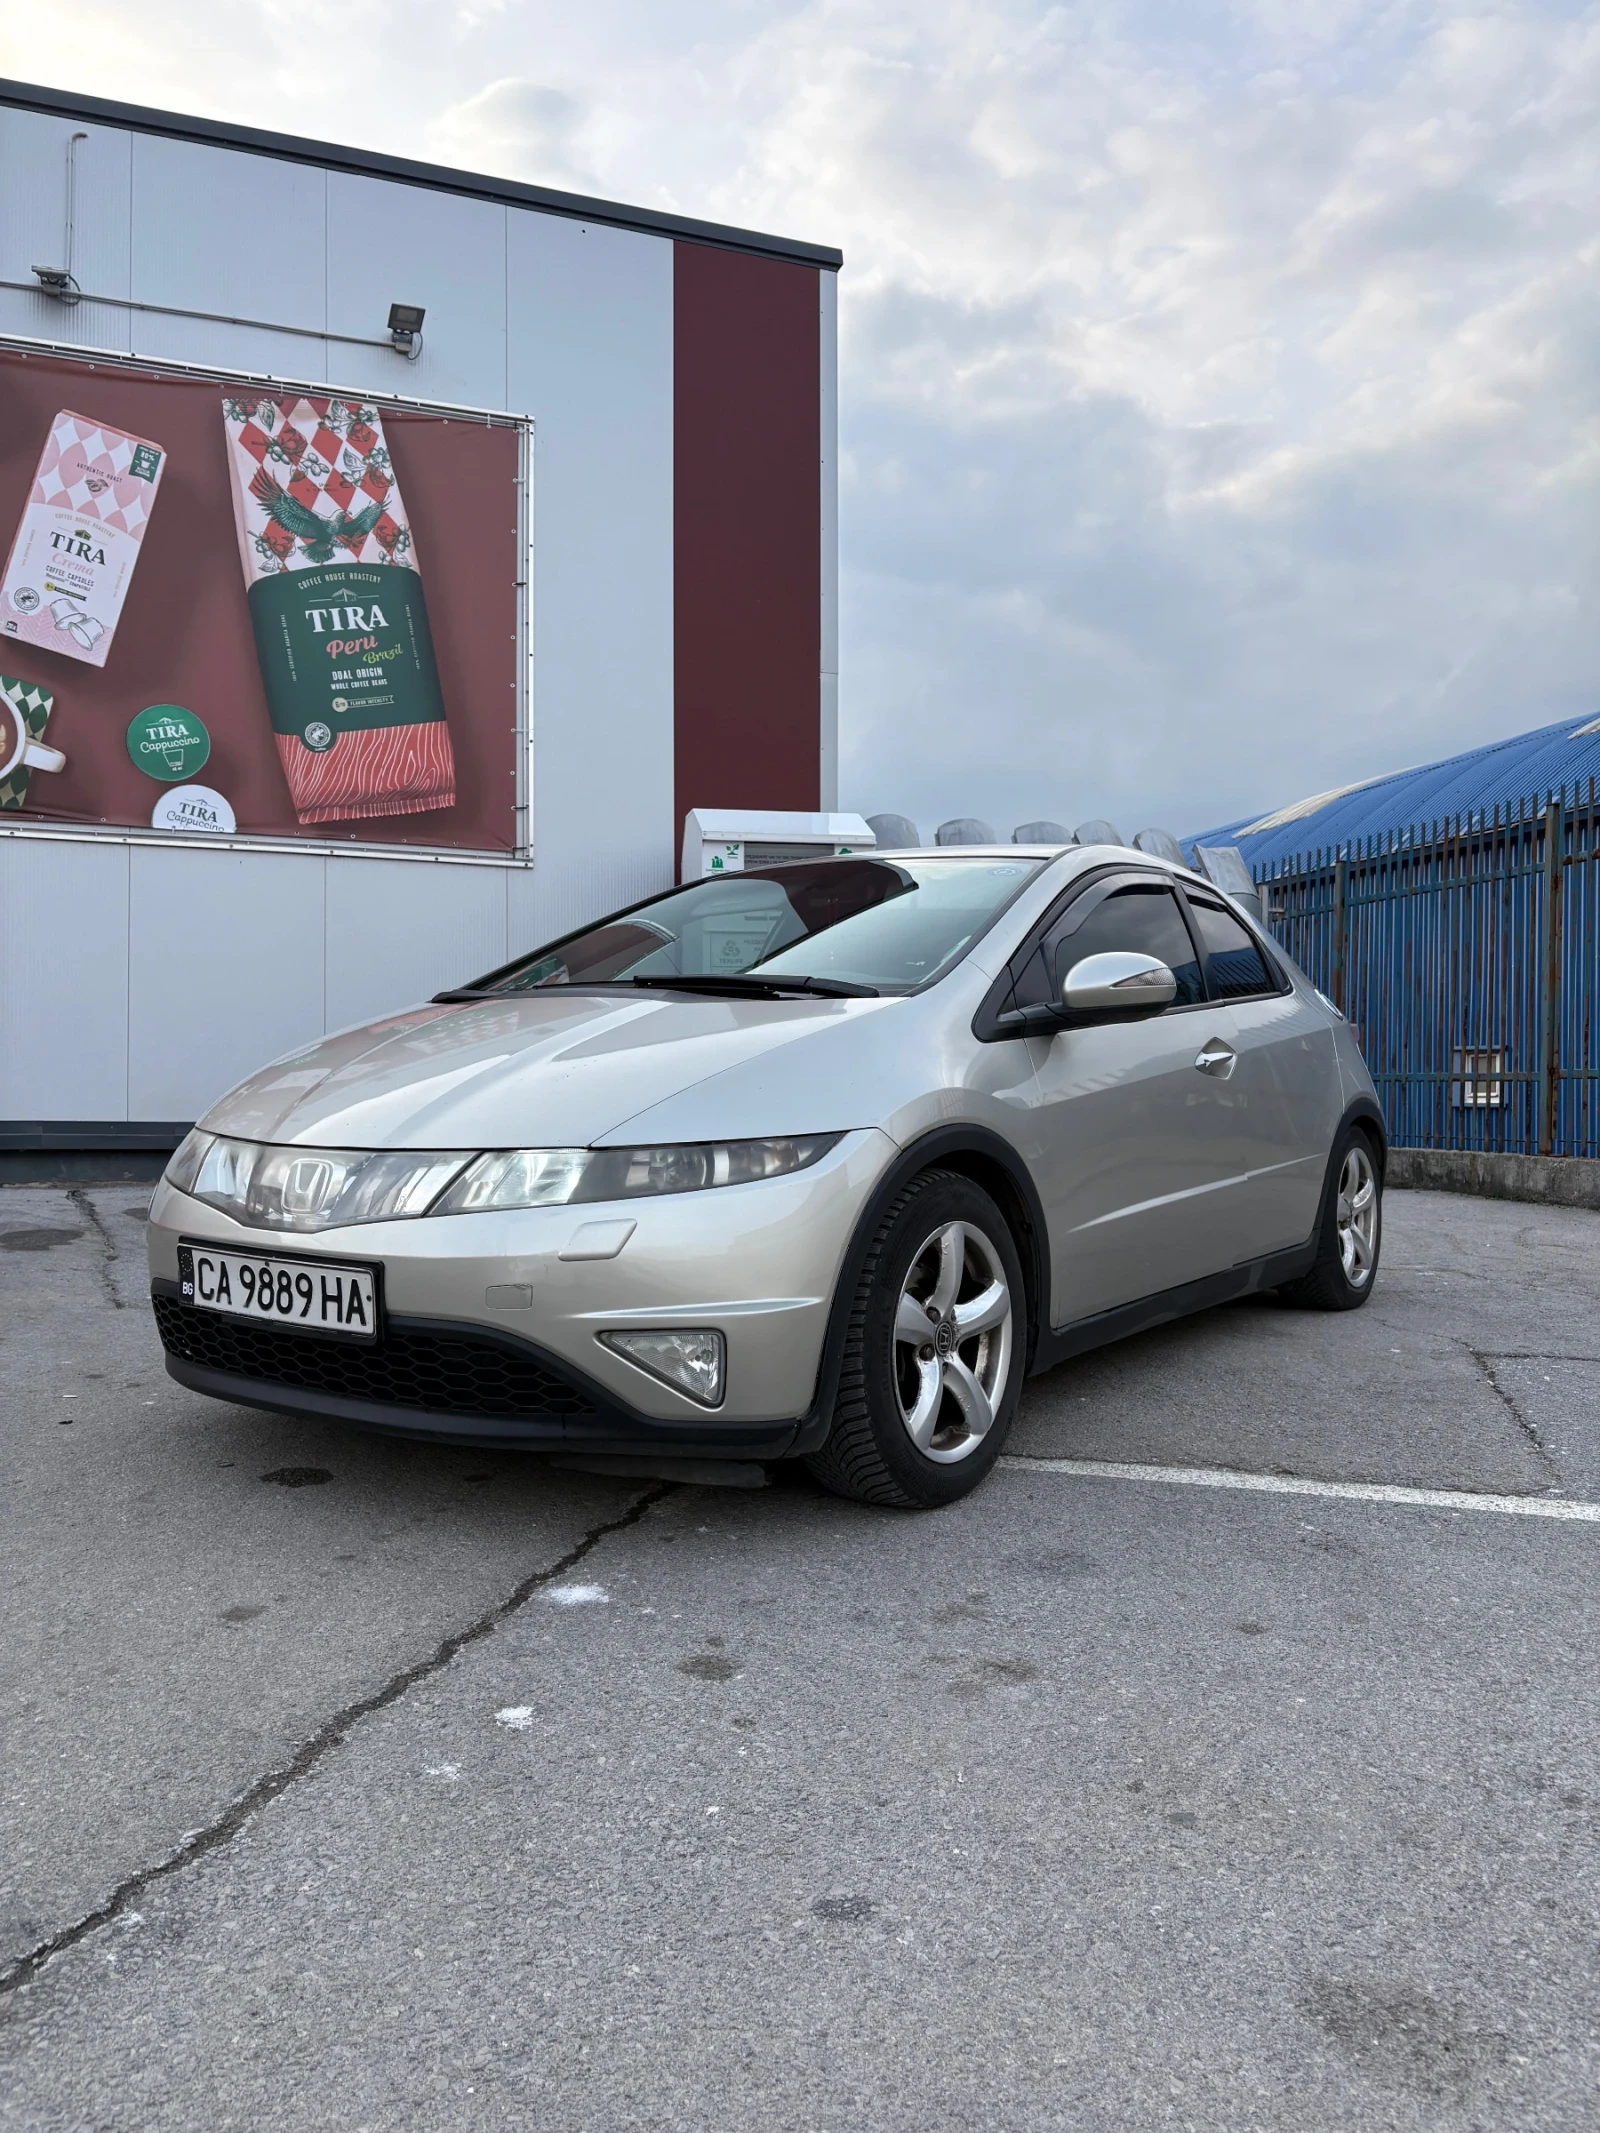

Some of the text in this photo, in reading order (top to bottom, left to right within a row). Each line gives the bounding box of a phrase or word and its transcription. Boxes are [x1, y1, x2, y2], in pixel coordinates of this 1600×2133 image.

[76, 462, 123, 484] AUTHENTIC ROAST
[49, 531, 106, 566] TIRA
[52, 553, 95, 576] Crema
[45, 565, 65, 577] COFFEE
[67, 572, 95, 587] CAPSULES
[298, 572, 382, 590] COFFEE HOUSE ROASTERY
[304, 604, 390, 633] TIRA
[326, 635, 379, 659] Peru
[362, 643, 404, 664] Brazil
[330, 679, 388, 690] WHOLE COFFEE BEANS
[331, 667, 383, 681] DUAL ORIGIN
[146, 723, 189, 740] TIRA
[140, 737, 200, 753] Cappuccino
[179, 802, 218, 823] TIRA
[182, 1281, 193, 1295] BG
[198, 1257, 367, 1326] CA 9889 HA
